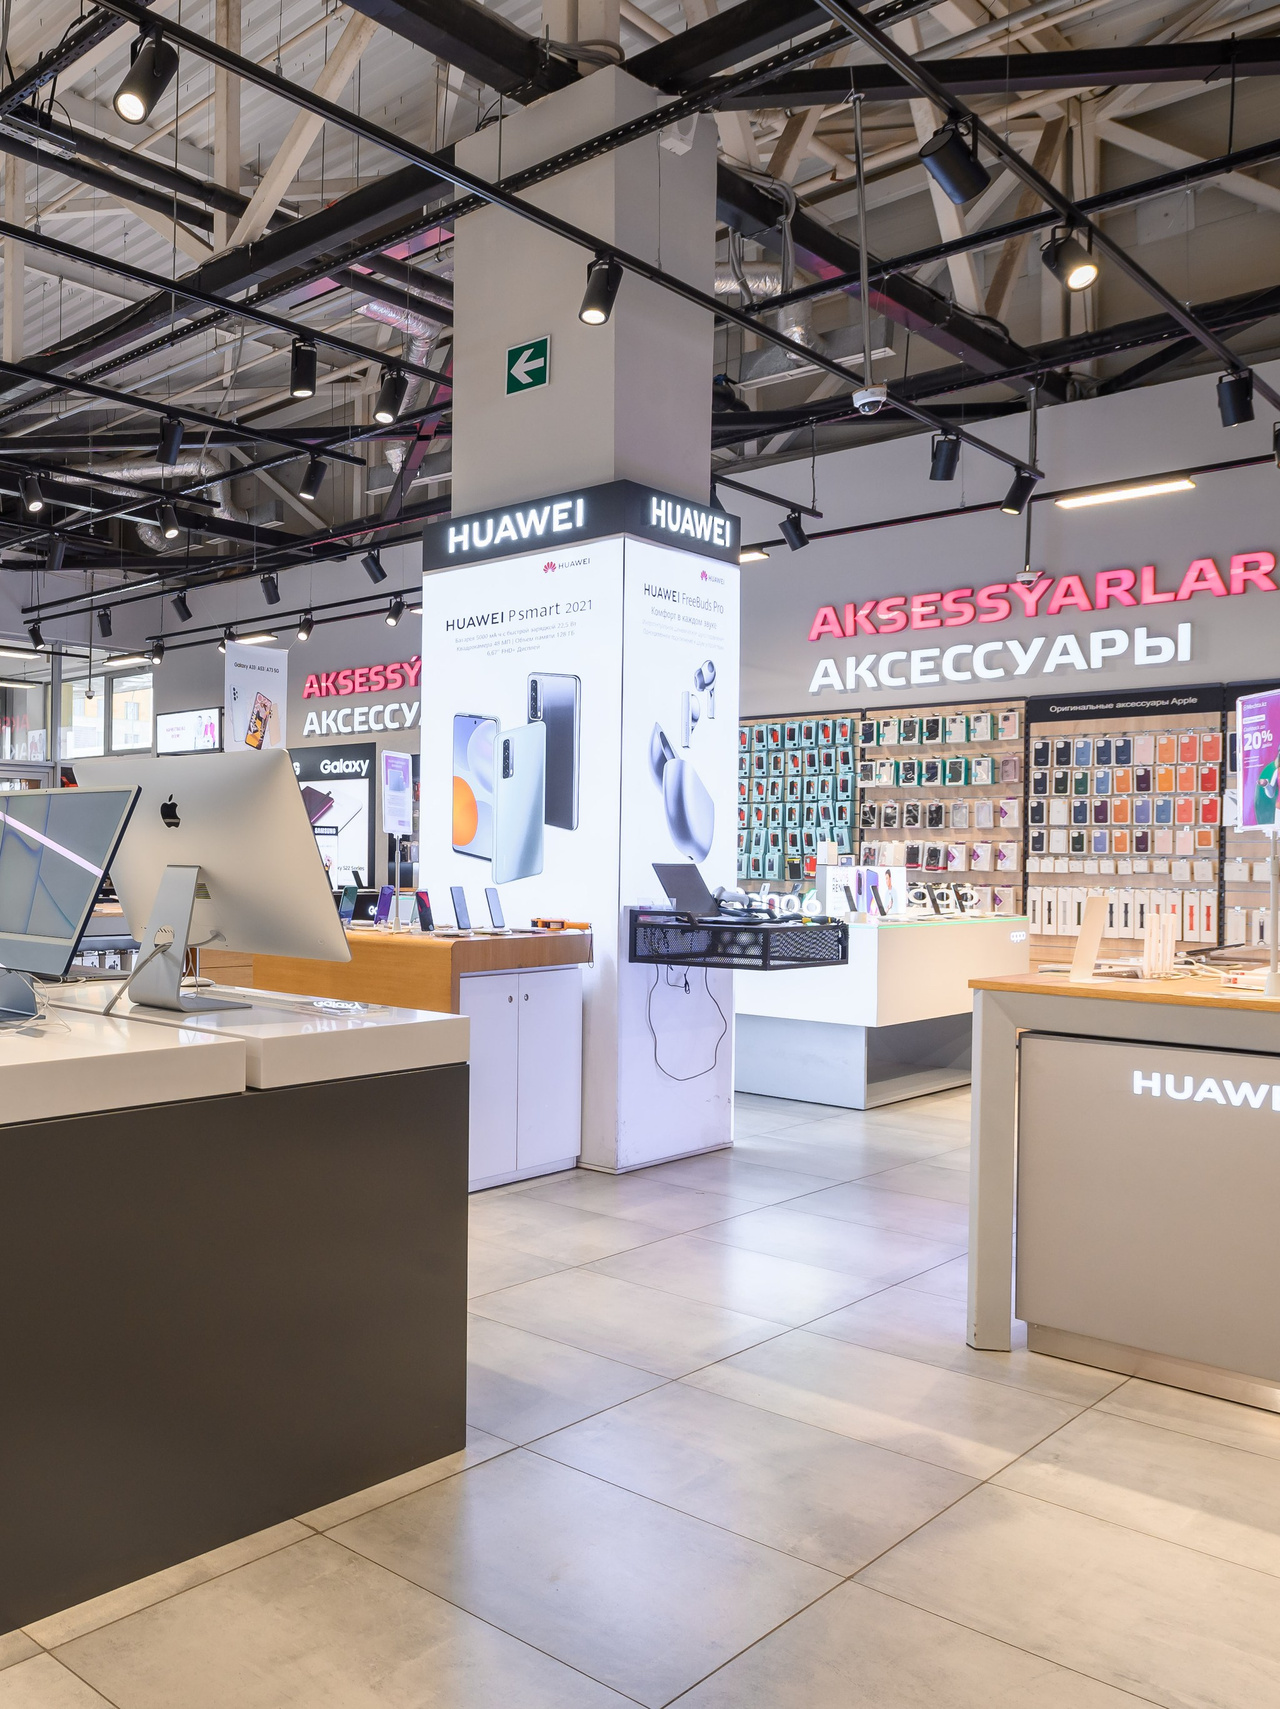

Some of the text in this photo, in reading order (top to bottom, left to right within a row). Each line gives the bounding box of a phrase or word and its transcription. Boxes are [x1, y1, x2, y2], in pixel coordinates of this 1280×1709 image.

[448, 498, 584, 553] HUAWEI
[651, 496, 731, 547] HUAWEI
[558, 557, 591, 570] HUAWEI
[708, 575, 725, 585] HUAWEI
[644, 583, 724, 615] HUAWEI FreeBuds Pro
[446, 611, 504, 632] HUAWEI
[519, 602, 561, 621] smart
[565, 599, 593, 614] 2021
[808, 622, 1191, 693] АКСЕССУАРЫ
[302, 655, 423, 699] AKSESSÝ
[302, 701, 423, 736] АКСЕССУ
[1049, 696, 1198, 713] Оригинальные аксессуары Apple
[1244, 730, 1273, 751] 20%
[320, 758, 370, 777] Galaxy
[314, 827, 337, 835] SAMSUNG
